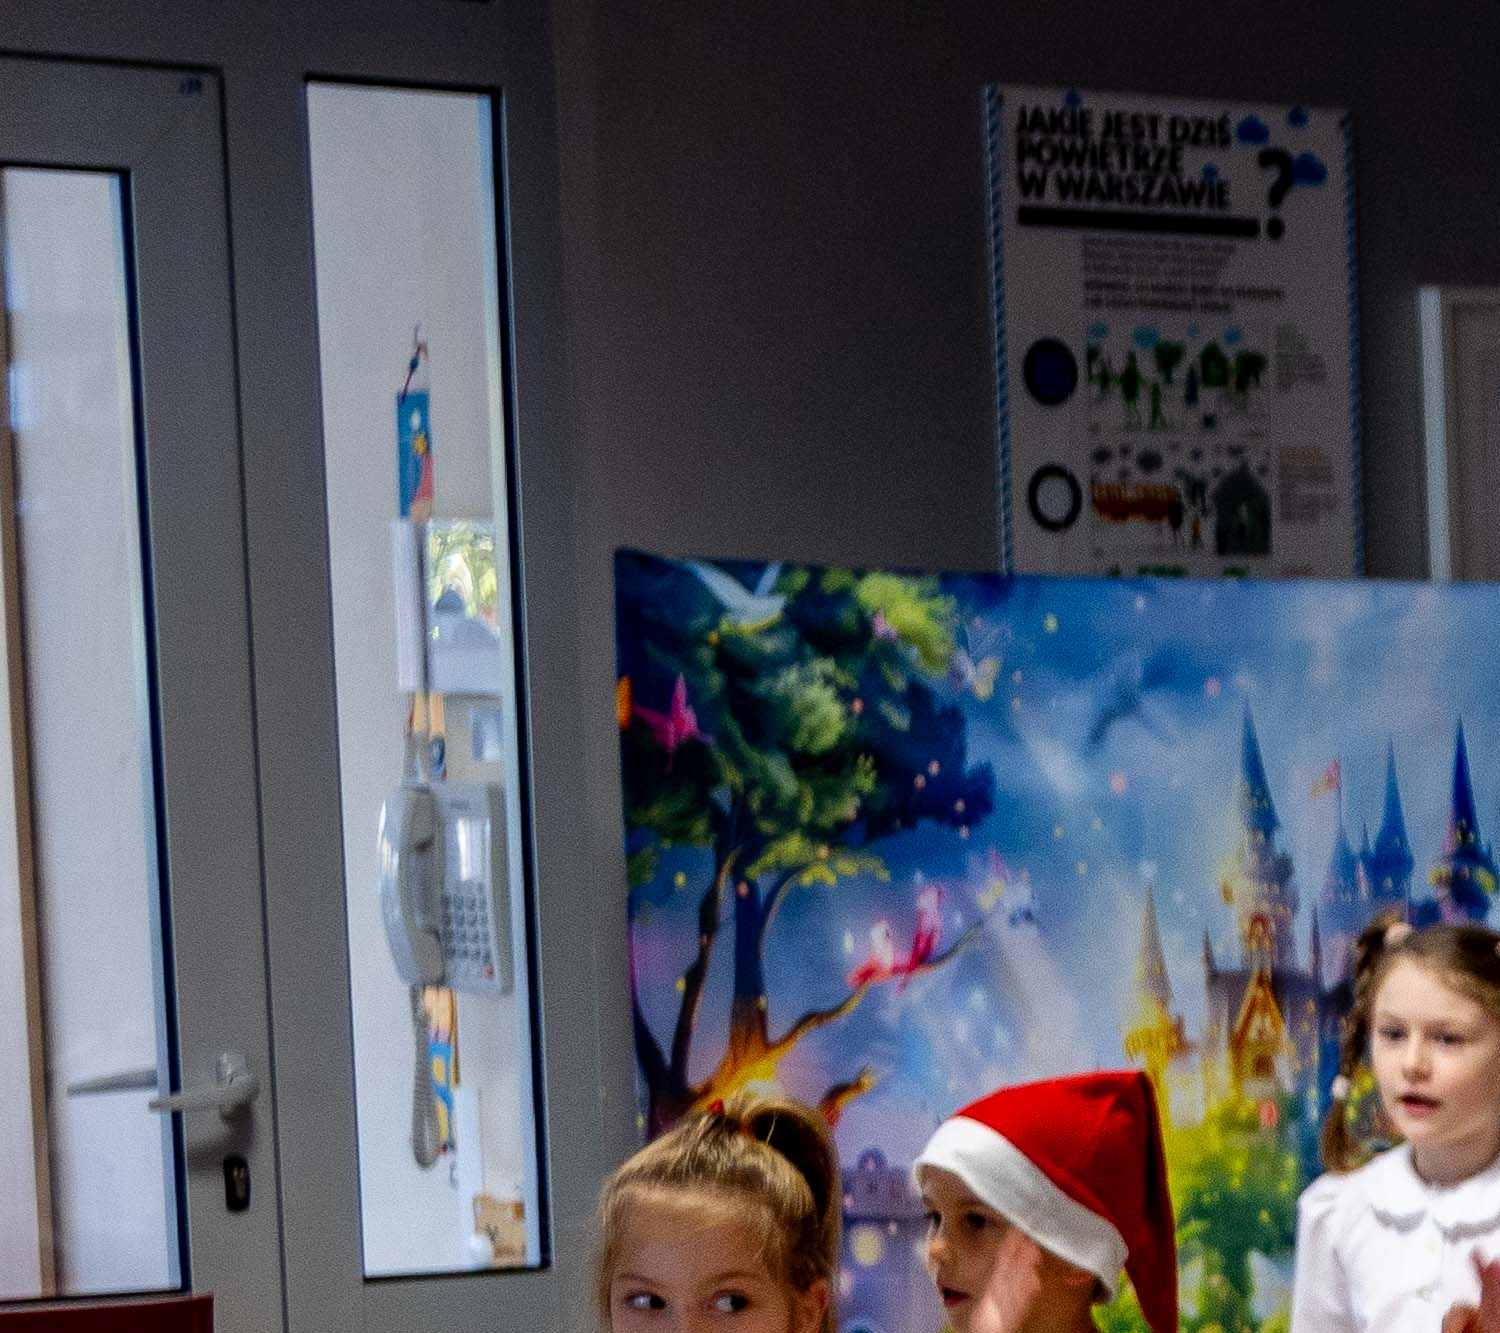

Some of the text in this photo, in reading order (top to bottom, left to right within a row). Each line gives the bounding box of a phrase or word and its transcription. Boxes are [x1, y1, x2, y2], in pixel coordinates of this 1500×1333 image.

[1017, 106, 1231, 147] JAKIE JEST DZIŚ
[1017, 136, 1184, 174] POWIETRZE
[1018, 171, 1230, 208] W WARSZAWIE
[1258, 147, 1294, 240] ?
